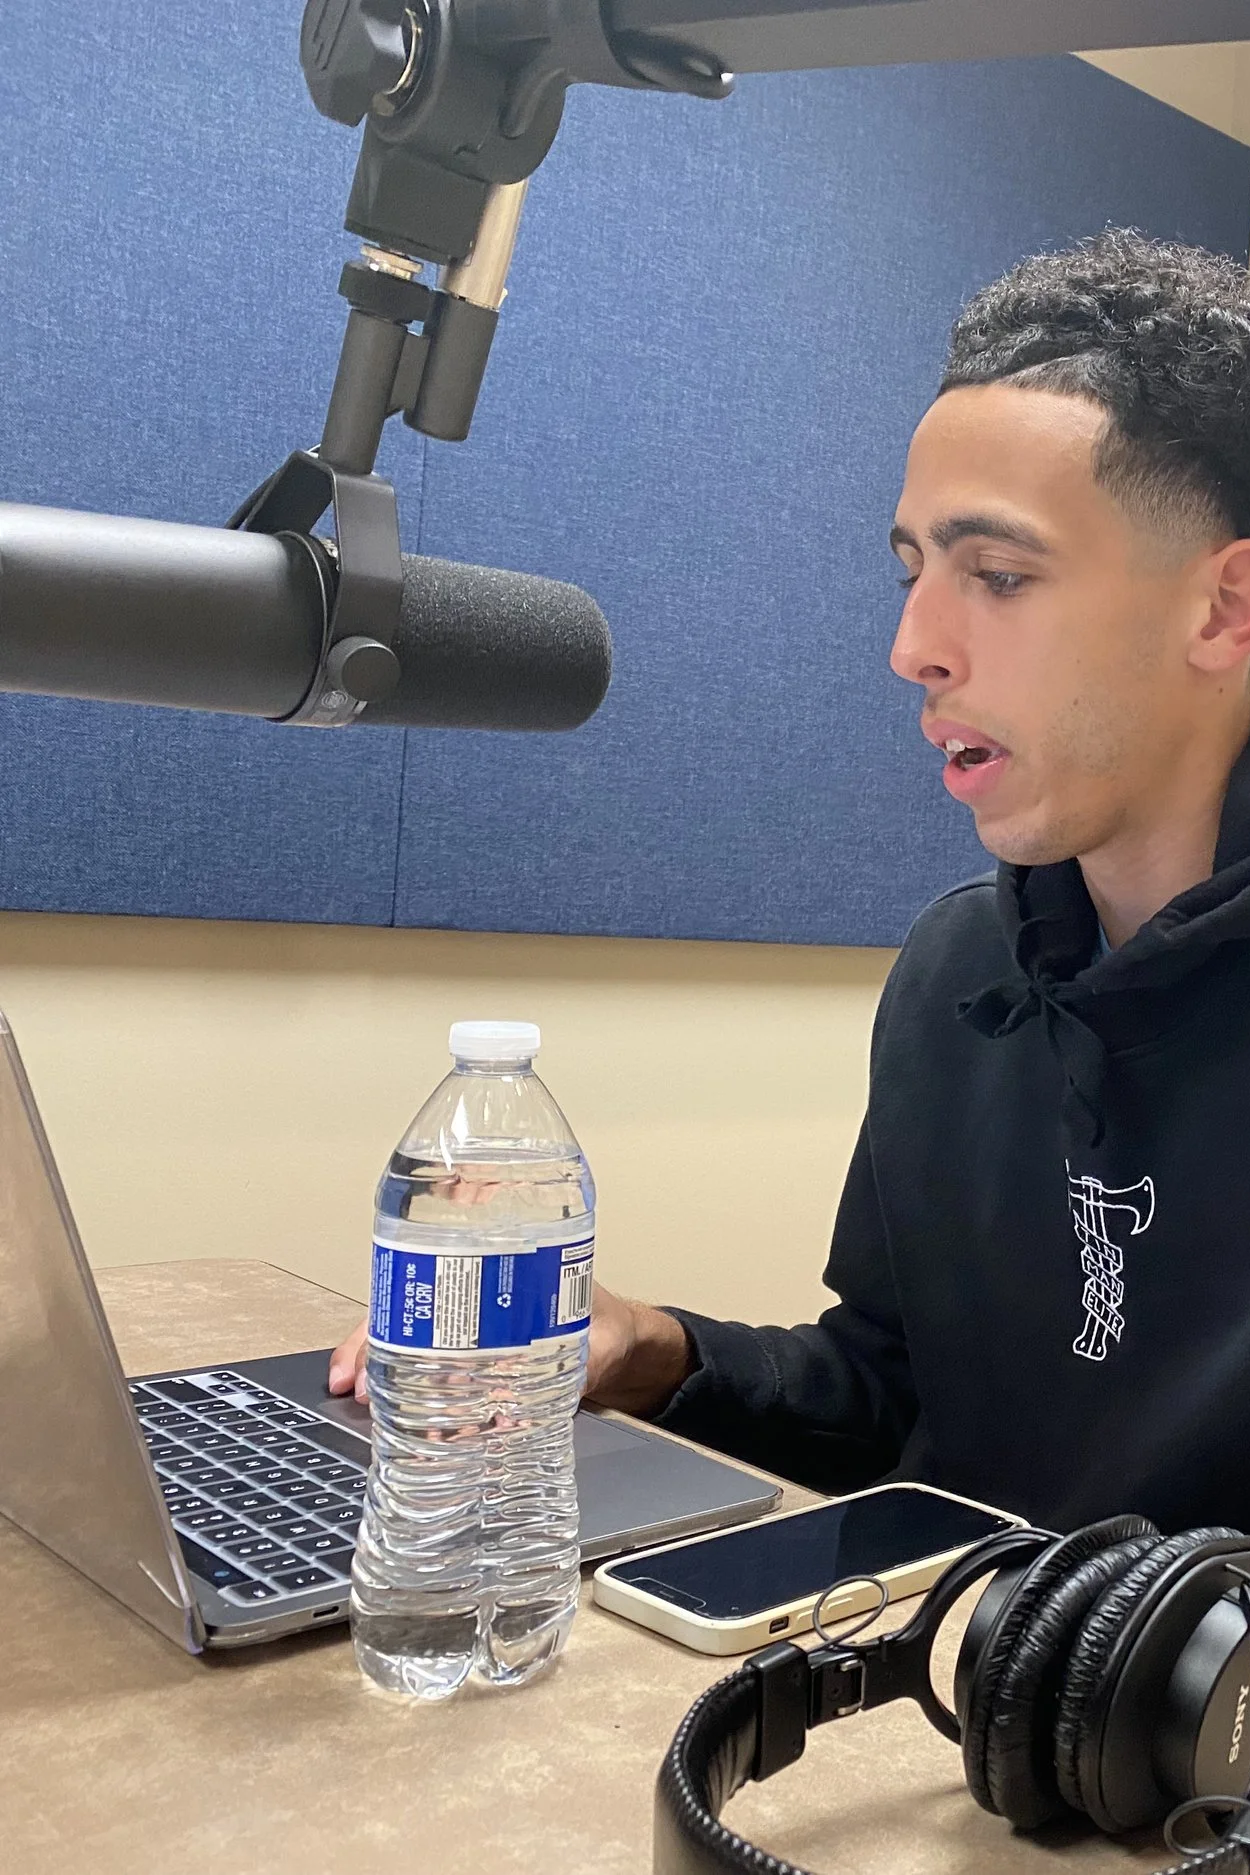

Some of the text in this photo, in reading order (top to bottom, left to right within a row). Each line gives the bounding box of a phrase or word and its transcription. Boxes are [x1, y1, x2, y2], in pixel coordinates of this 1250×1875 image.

[1087, 1260, 1122, 1295] MAN
[414, 1282, 434, 1320] CA CRV
[1086, 1291, 1120, 1332] ELITE
[1228, 1684, 1250, 1764] SONY
